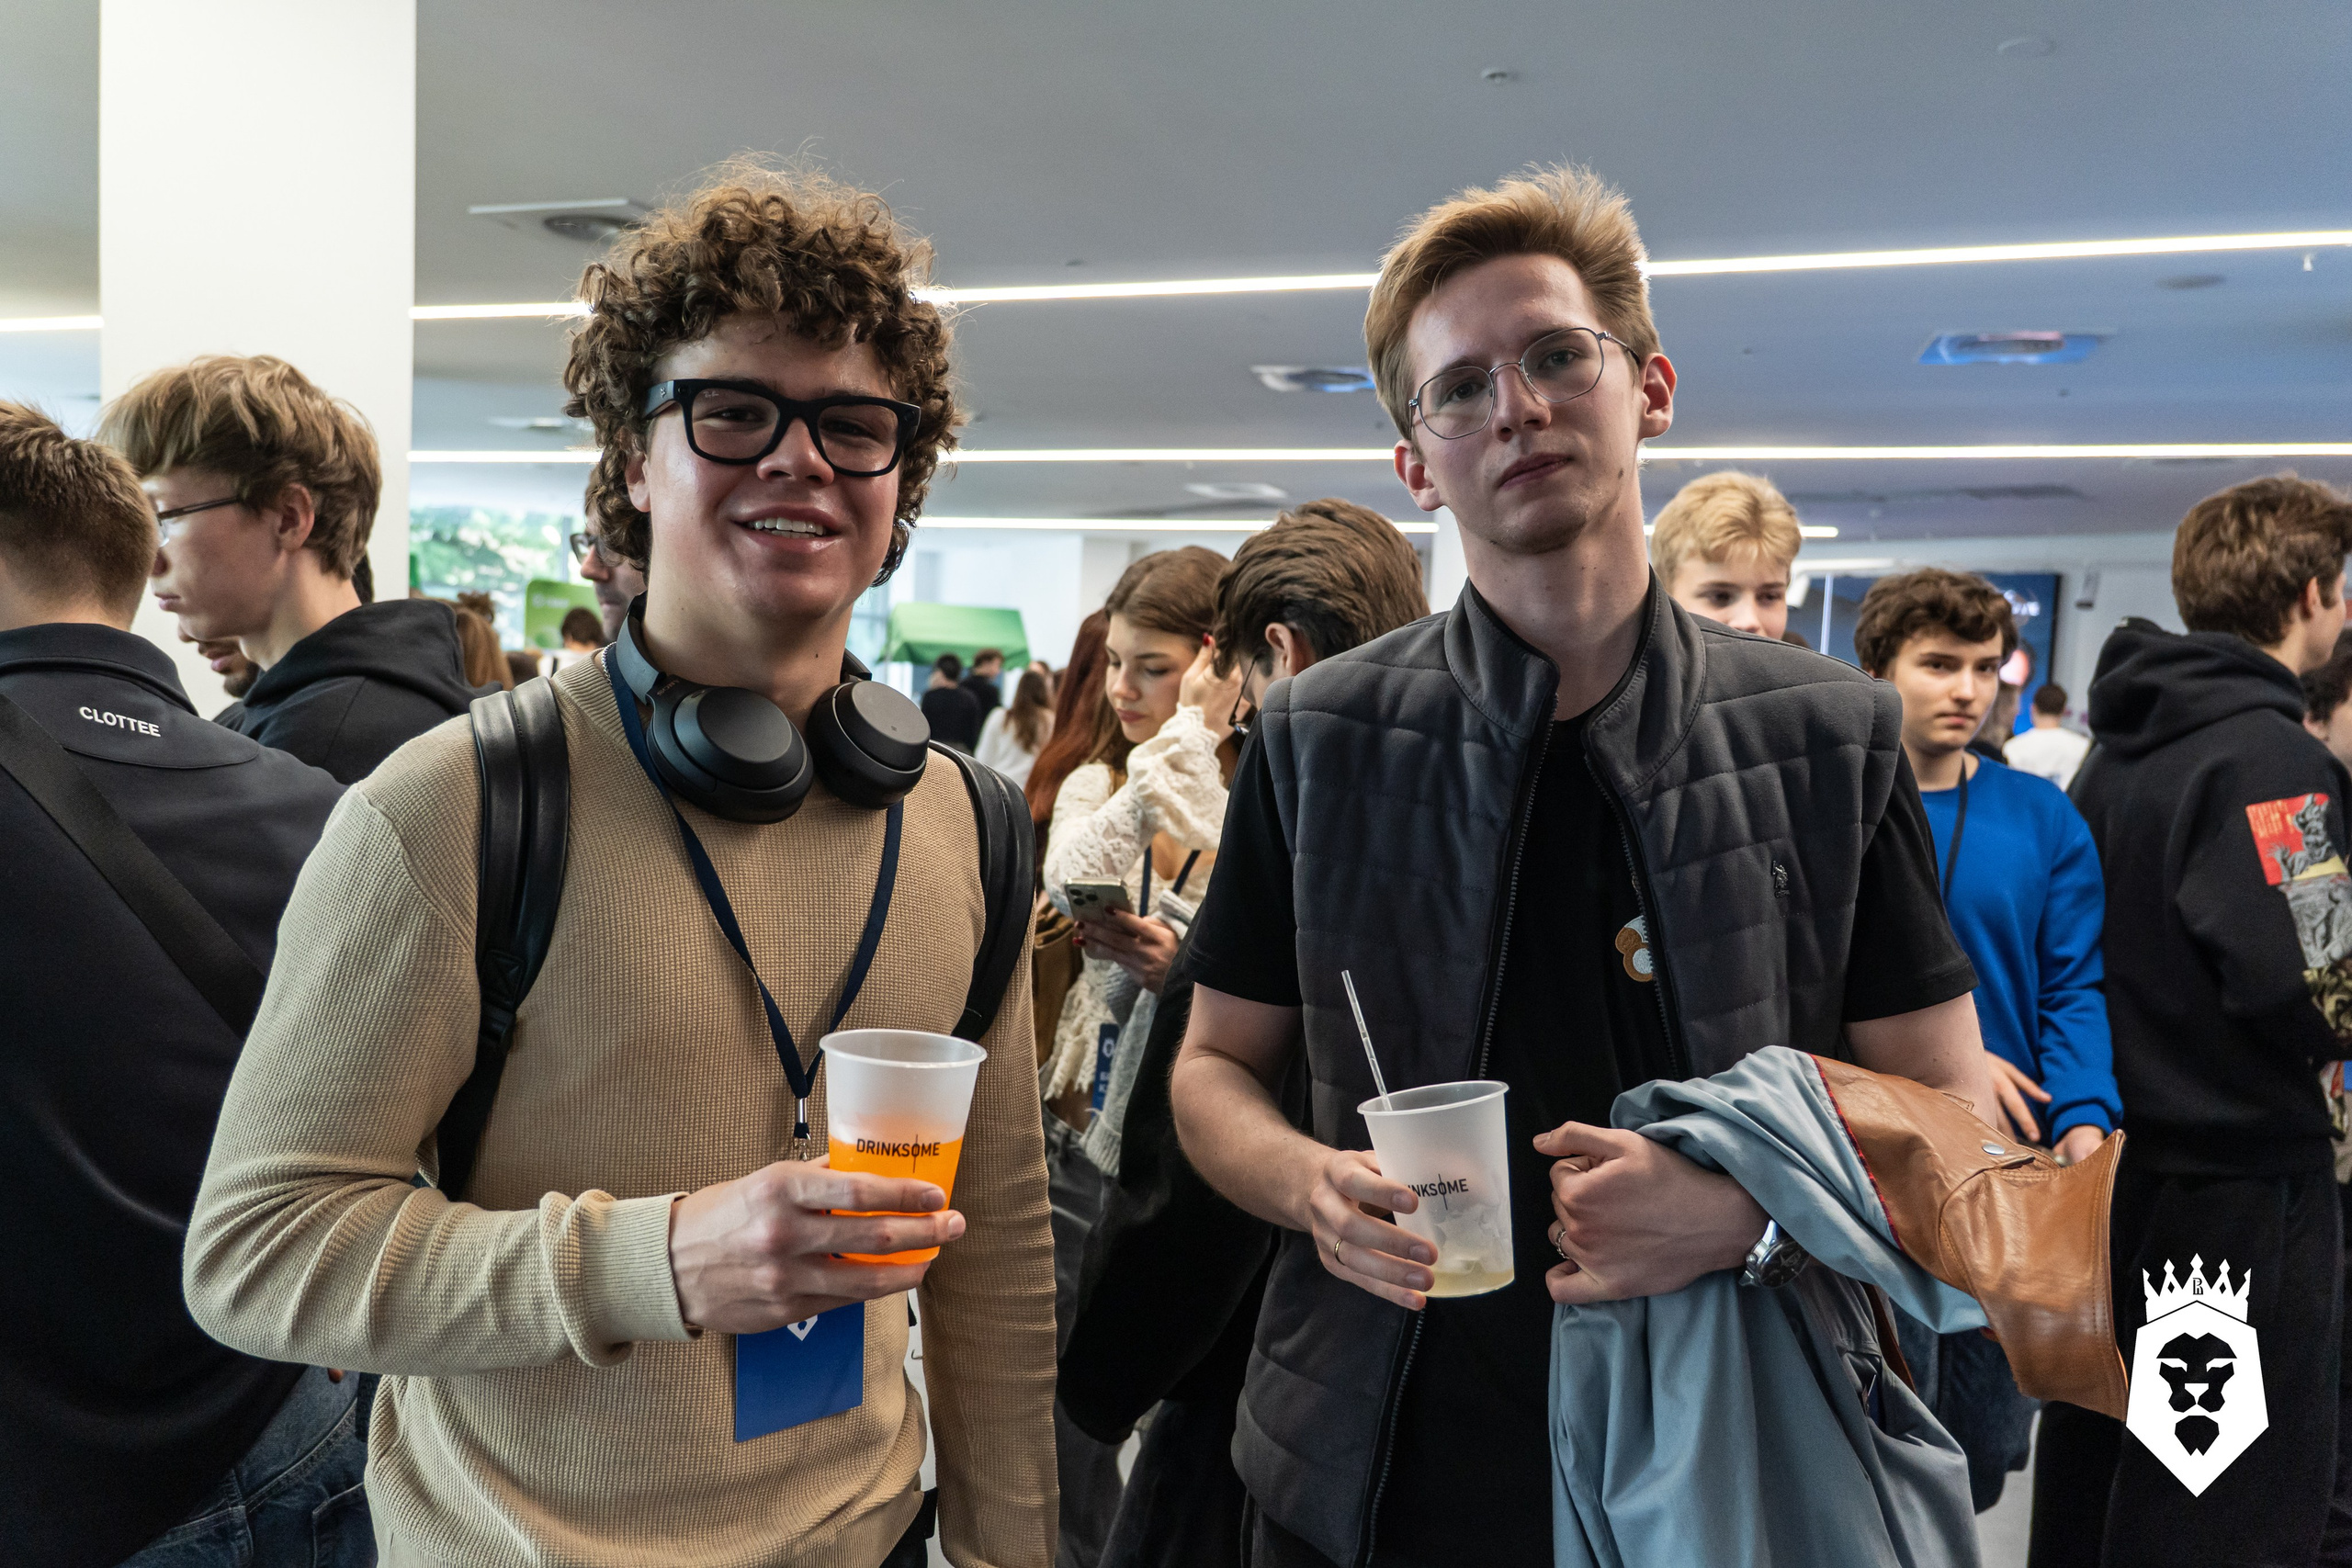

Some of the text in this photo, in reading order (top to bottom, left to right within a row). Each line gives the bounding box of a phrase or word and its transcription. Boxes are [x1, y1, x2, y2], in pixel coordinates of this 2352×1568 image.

[79, 706, 161, 738] CLOTTEE
[856, 1137, 941, 1158] DRINKSOME
[1408, 1177, 1469, 1198] NKSOME
